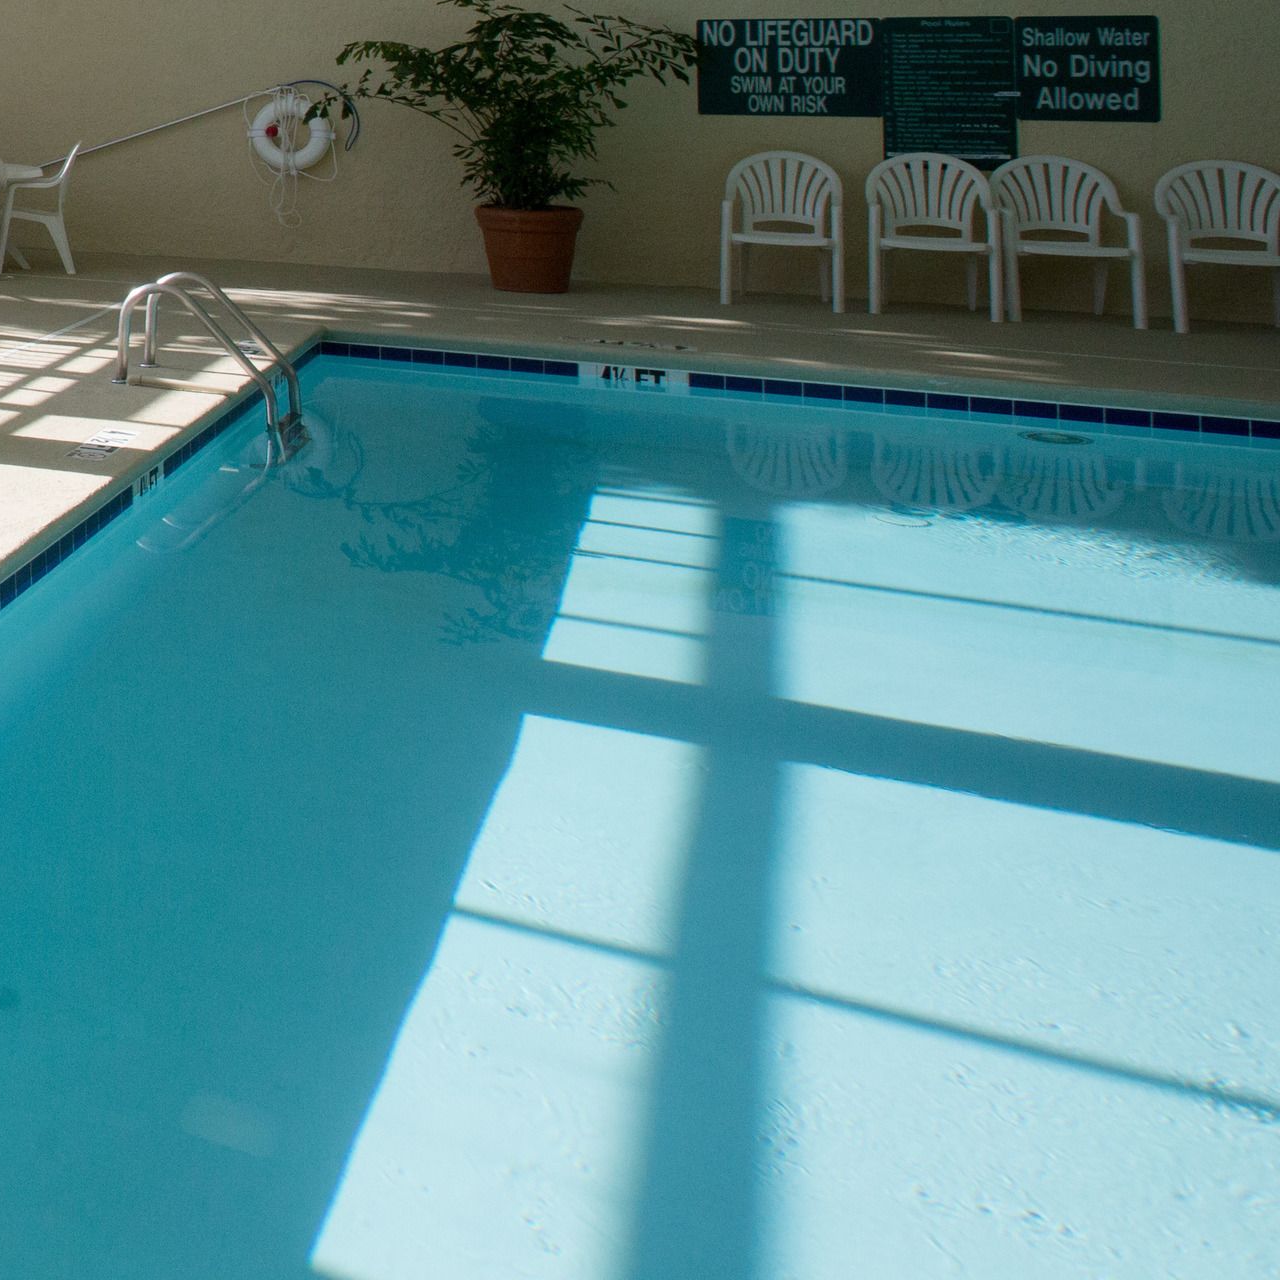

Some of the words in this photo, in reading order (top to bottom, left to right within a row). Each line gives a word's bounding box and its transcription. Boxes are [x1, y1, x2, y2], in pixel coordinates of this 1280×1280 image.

[703, 20, 736, 47] NO
[745, 20, 873, 47] LIFEGUARD
[1022, 27, 1090, 46] Shallow
[1097, 27, 1151, 46] Water
[734, 47, 767, 73] ON
[777, 47, 840, 73] DUTY
[1023, 54, 1058, 77] No
[1070, 54, 1151, 84] Diving
[731, 76, 772, 94] SWIM
[779, 76, 797, 94] AT
[803, 76, 846, 94] YOUR
[748, 95, 785, 113] OWN
[791, 95, 828, 114] RISK
[1036, 86, 1140, 111] Allowed
